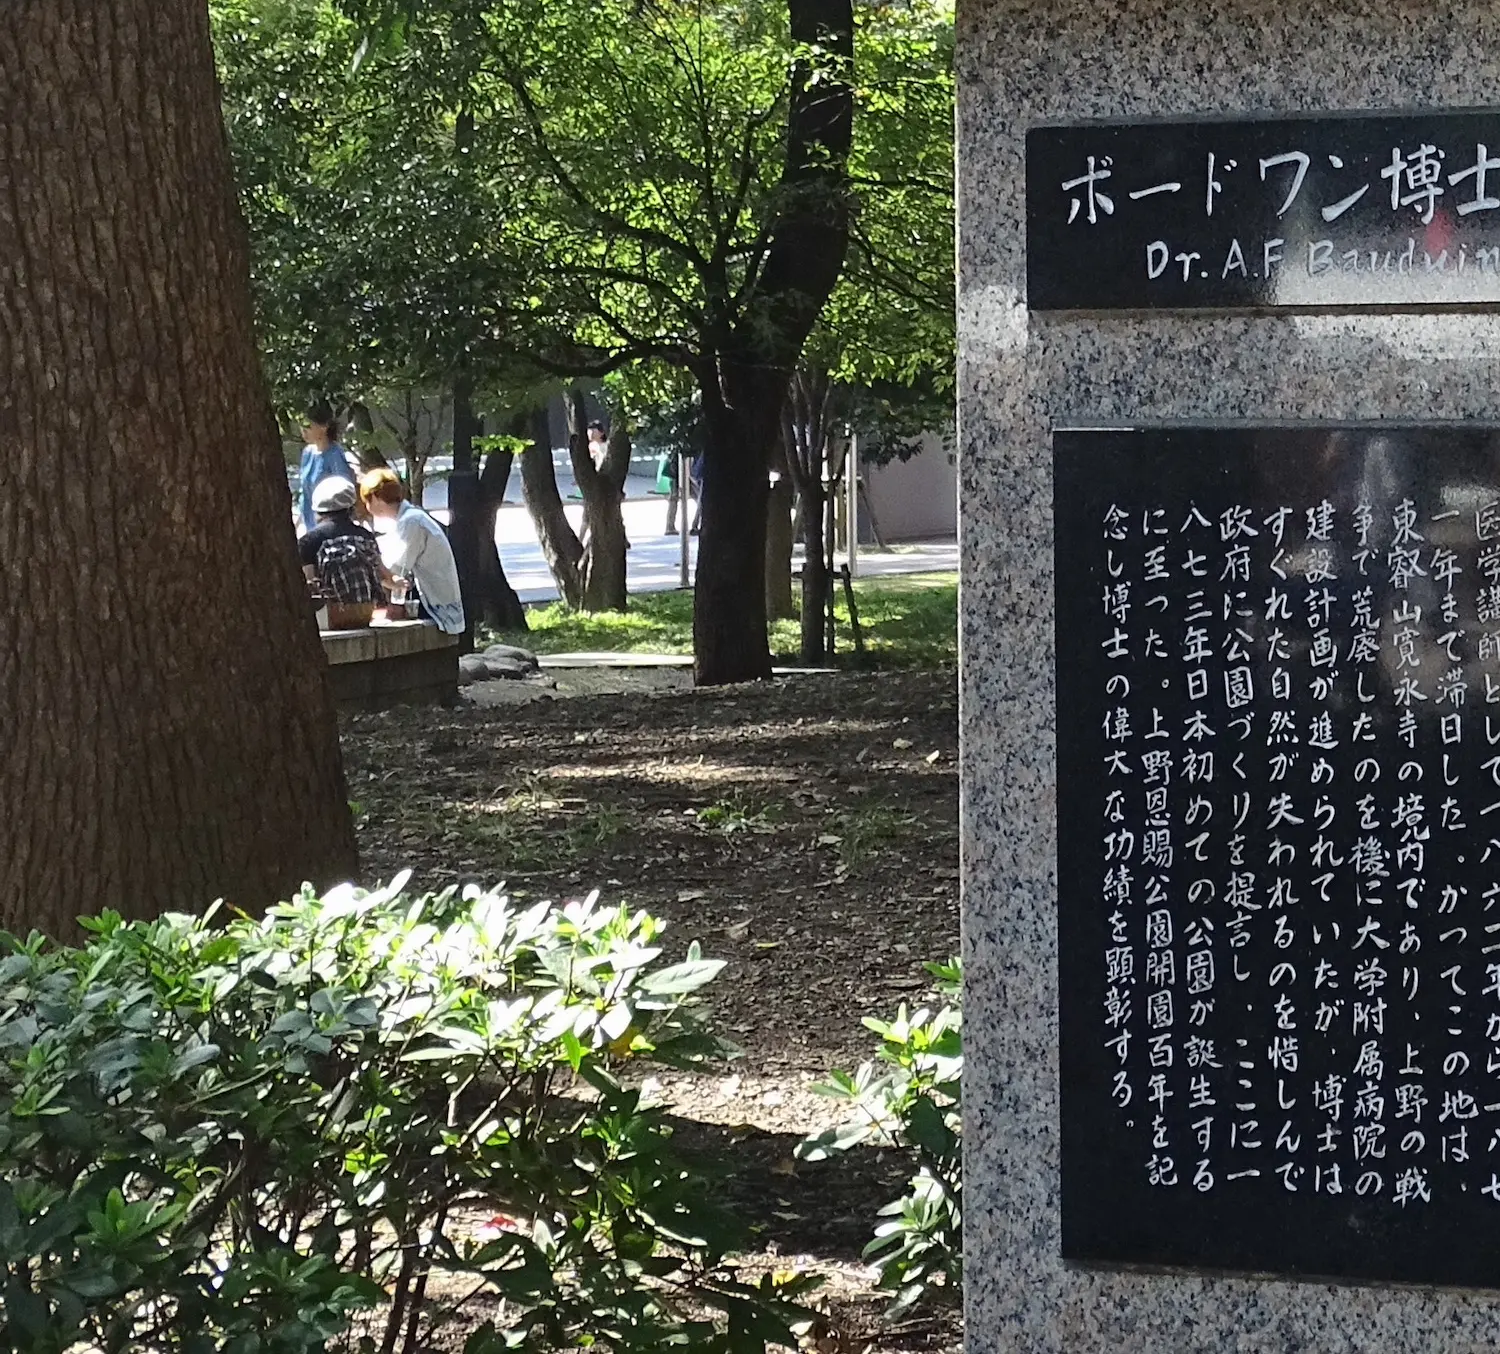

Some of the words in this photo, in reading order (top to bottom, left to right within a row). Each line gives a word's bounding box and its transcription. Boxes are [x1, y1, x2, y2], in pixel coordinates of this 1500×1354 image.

[1145, 240, 1209, 282] Dr.
[1100, 502, 1137, 1129] 念し博士の偉大な功績を顕彰する。
[1140, 507, 1179, 1187] に至った。上野恩賜公園開園百年を記
[1179, 506, 1223, 1193] 八七三年日本初めての公園が誕生する
[1262, 504, 1305, 1192] すぐれた自然が失われるのを惜しんで
[1346, 503, 1391, 1197] 争で荒廃したのを機に大学附属病院の
